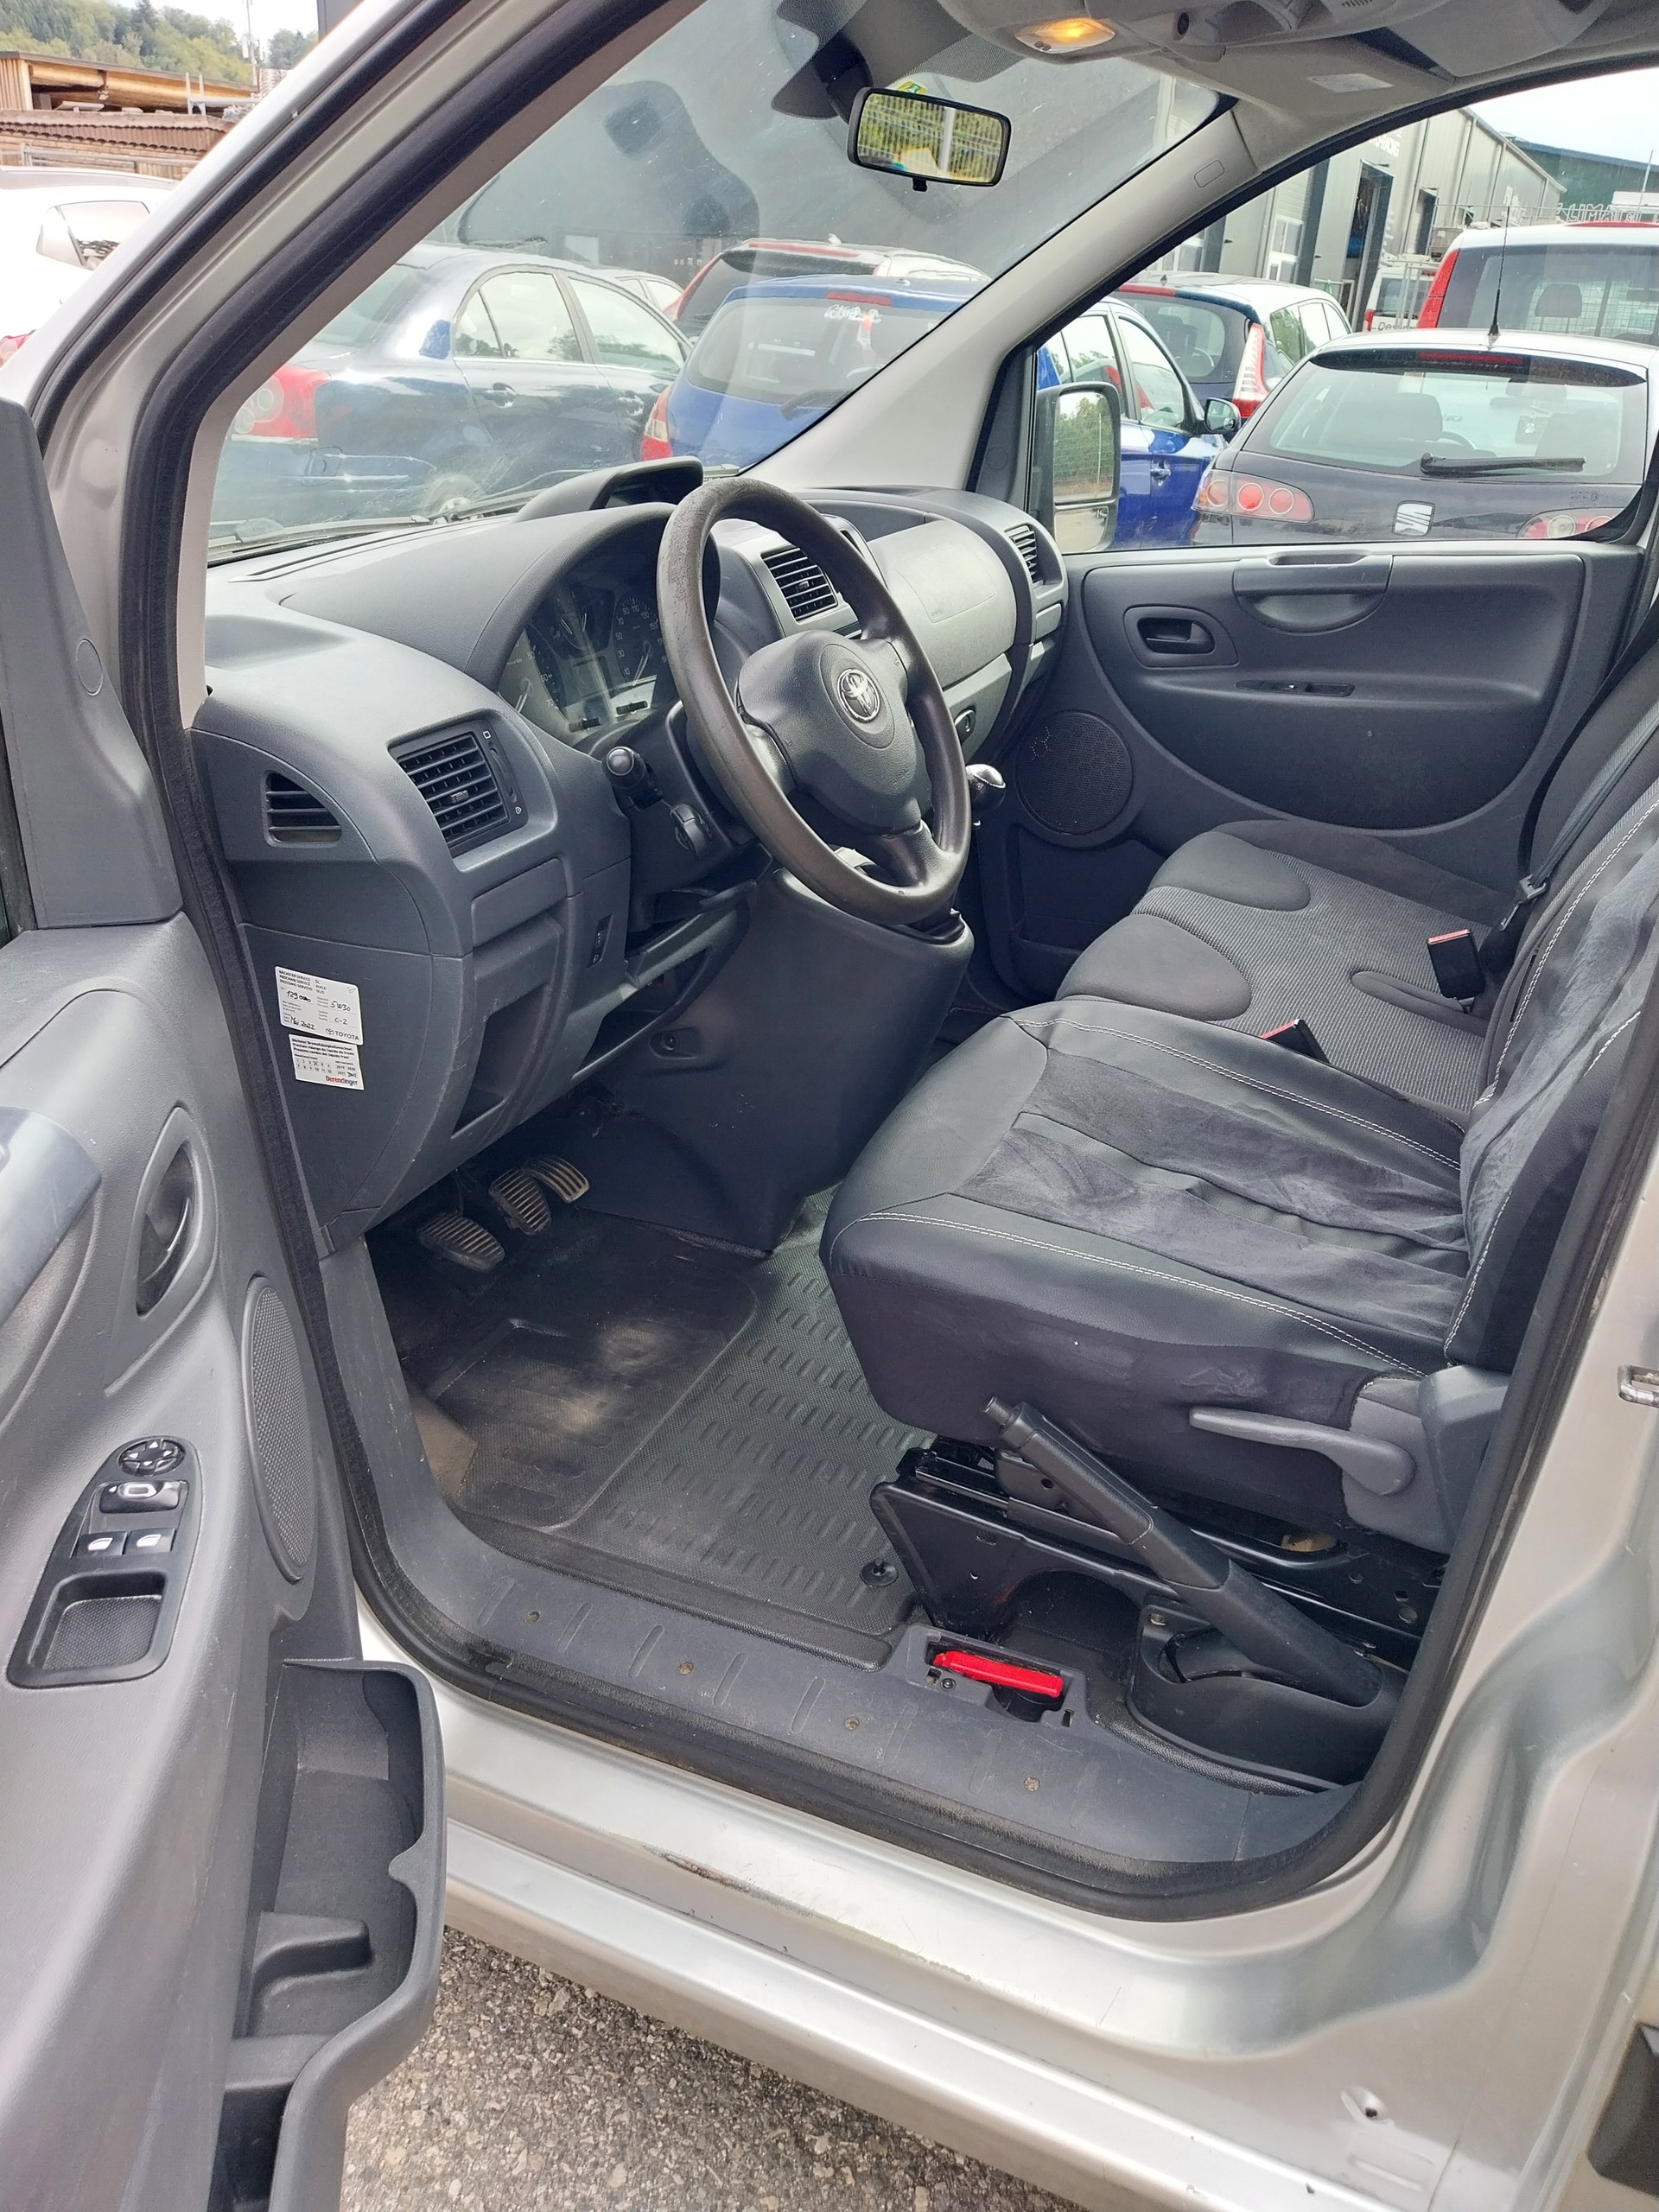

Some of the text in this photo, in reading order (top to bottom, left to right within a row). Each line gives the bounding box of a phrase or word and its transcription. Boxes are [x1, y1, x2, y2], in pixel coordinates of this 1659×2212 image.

[616, 617, 625, 626] 70
[615, 632, 623, 641] 50
[617, 650, 625, 658] 30
[623, 667, 631, 676] 10
[546, 698, 555, 708] 70
[334, 1030, 360, 1041] TOYOTA
